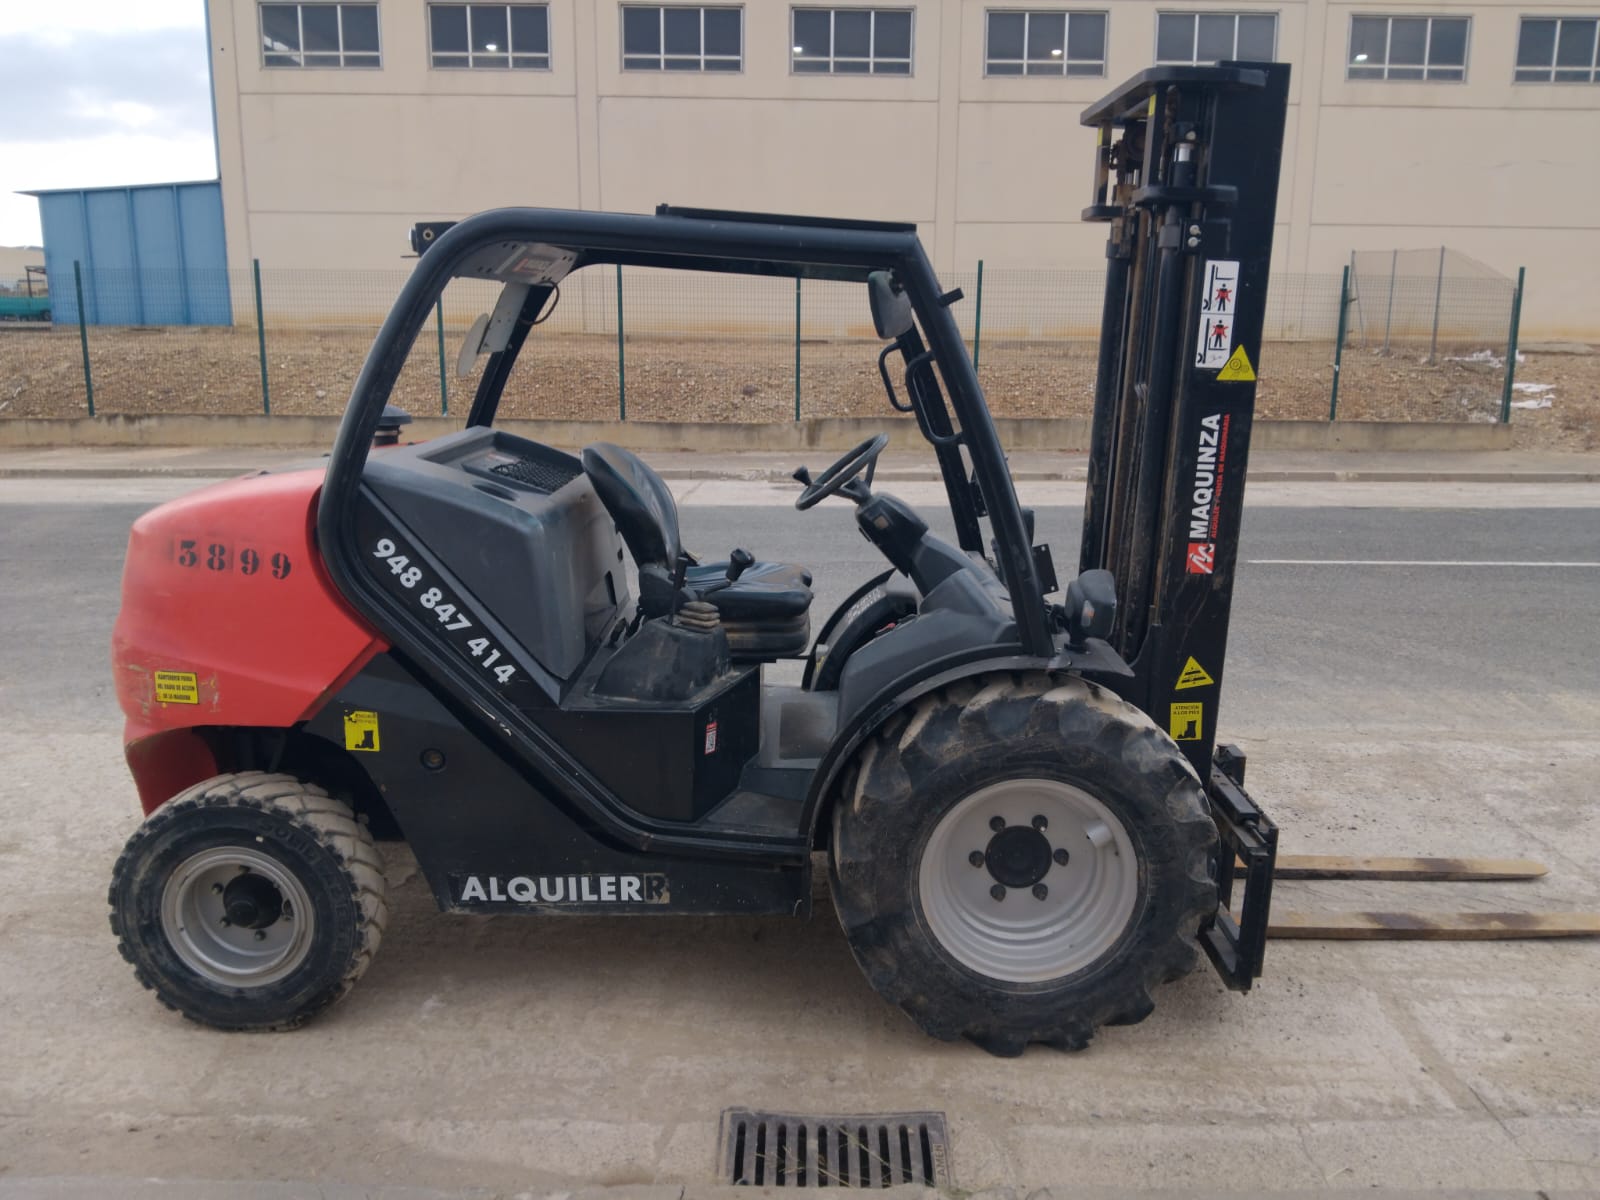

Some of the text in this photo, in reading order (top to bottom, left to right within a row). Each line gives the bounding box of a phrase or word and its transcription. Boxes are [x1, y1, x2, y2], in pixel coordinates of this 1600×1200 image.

[1189, 413, 1221, 539] MAQUINZA
[372, 538, 516, 683] 948 847 414
